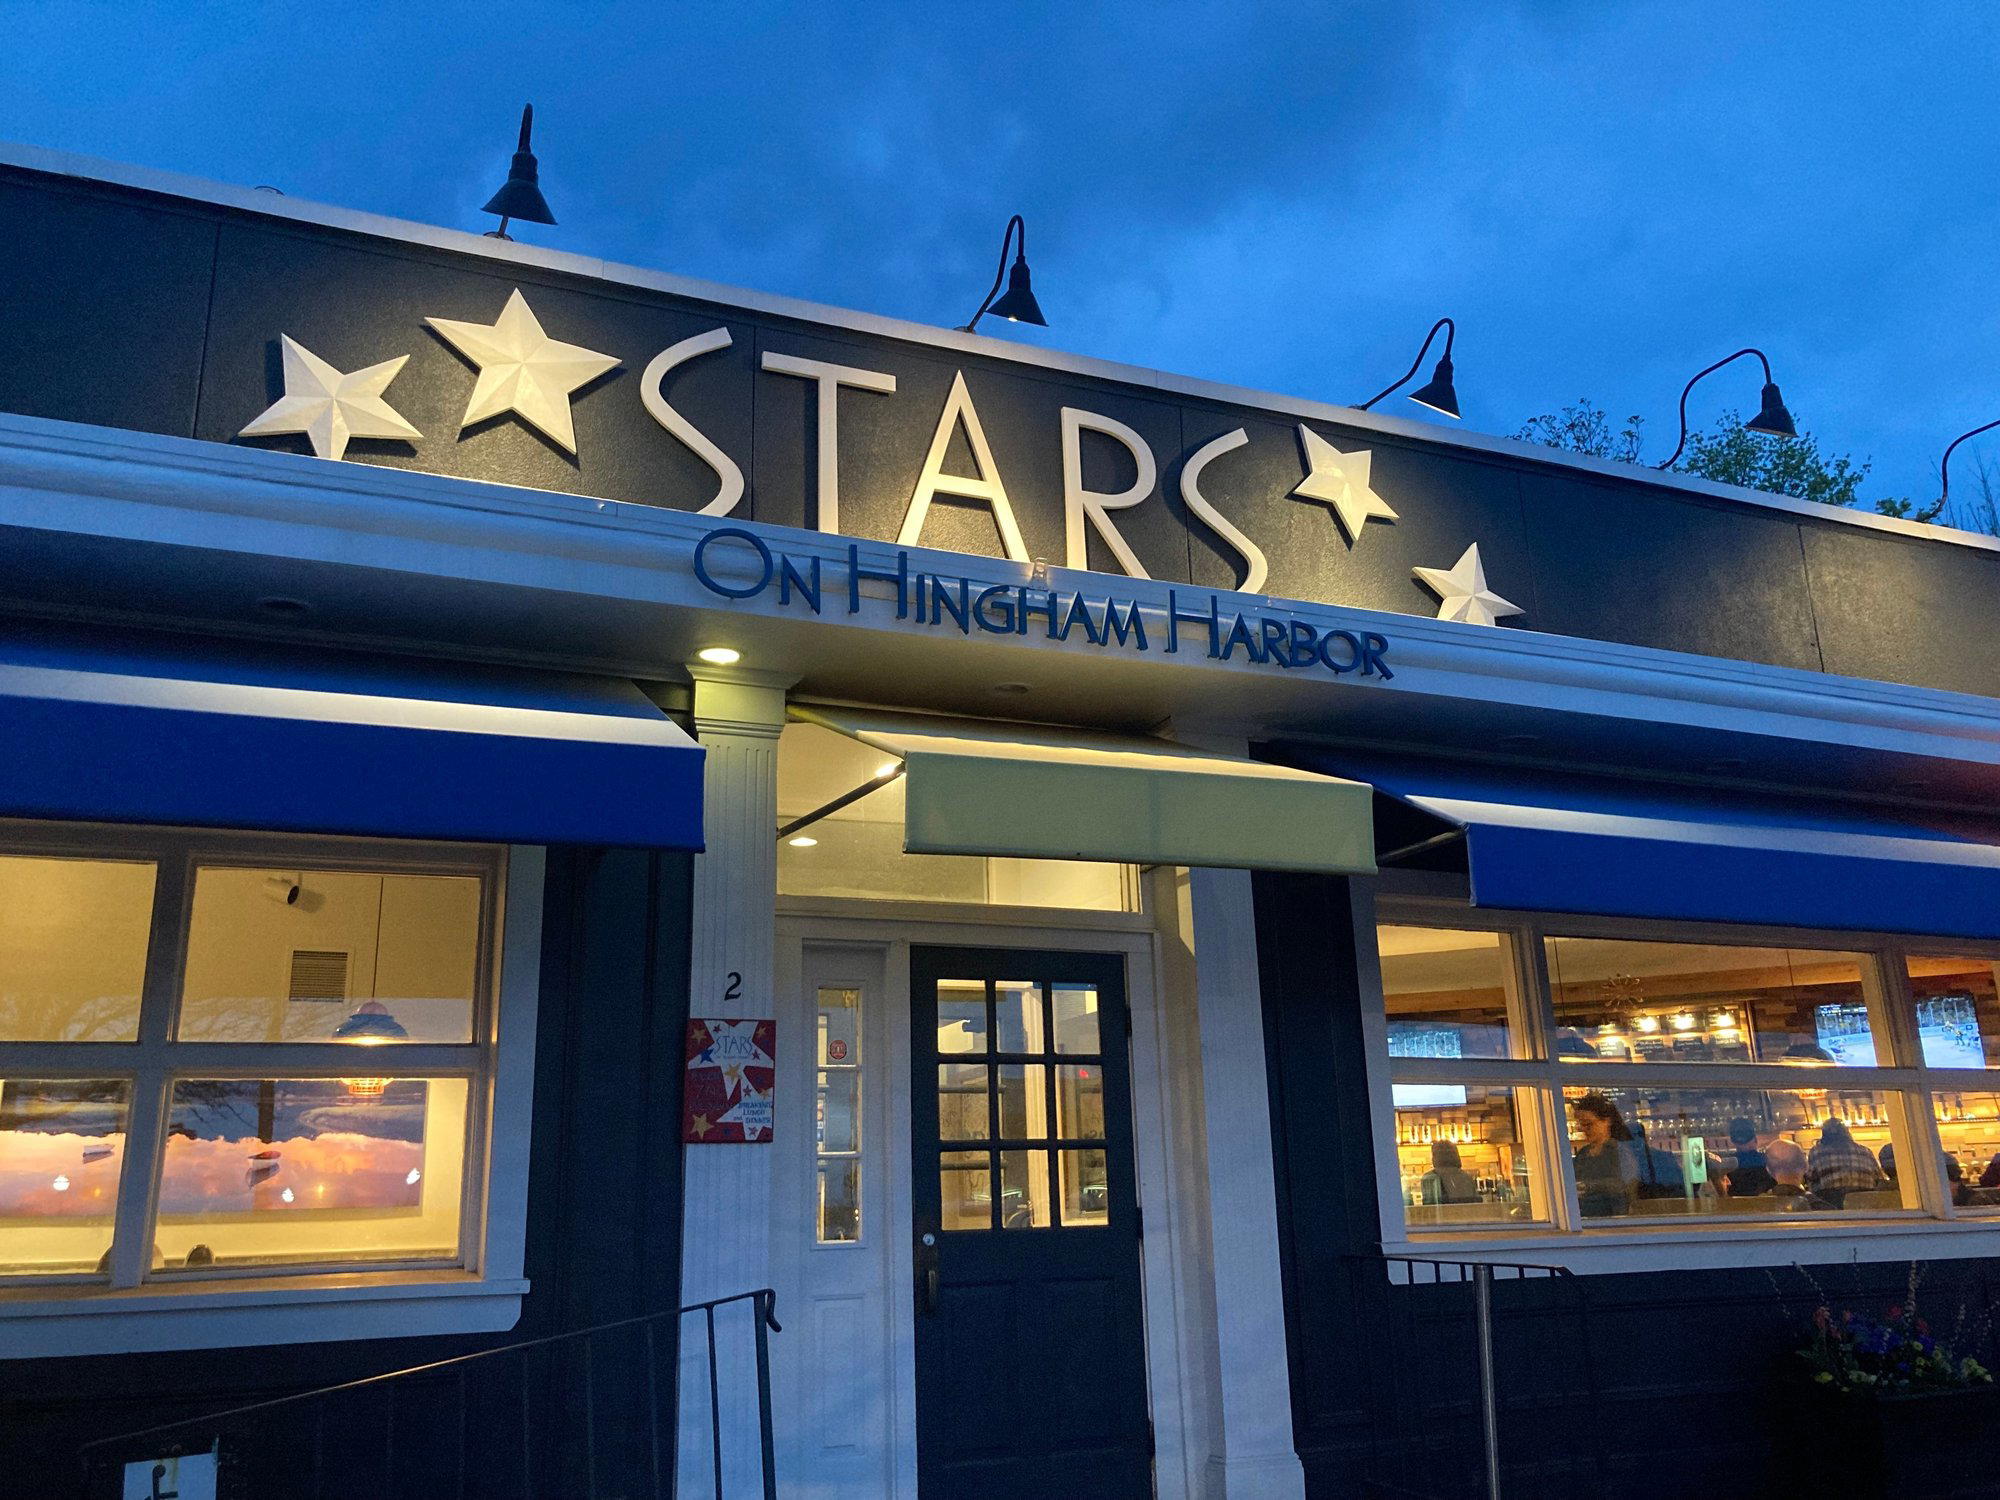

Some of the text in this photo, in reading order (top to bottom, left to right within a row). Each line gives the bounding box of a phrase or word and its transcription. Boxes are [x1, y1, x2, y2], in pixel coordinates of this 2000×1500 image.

[640, 326, 1267, 593] STARS
[694, 527, 1395, 681] ON HINGHAM HARBOR
[724, 971, 742, 1001] 2
[715, 1035, 753, 1055] STARS
